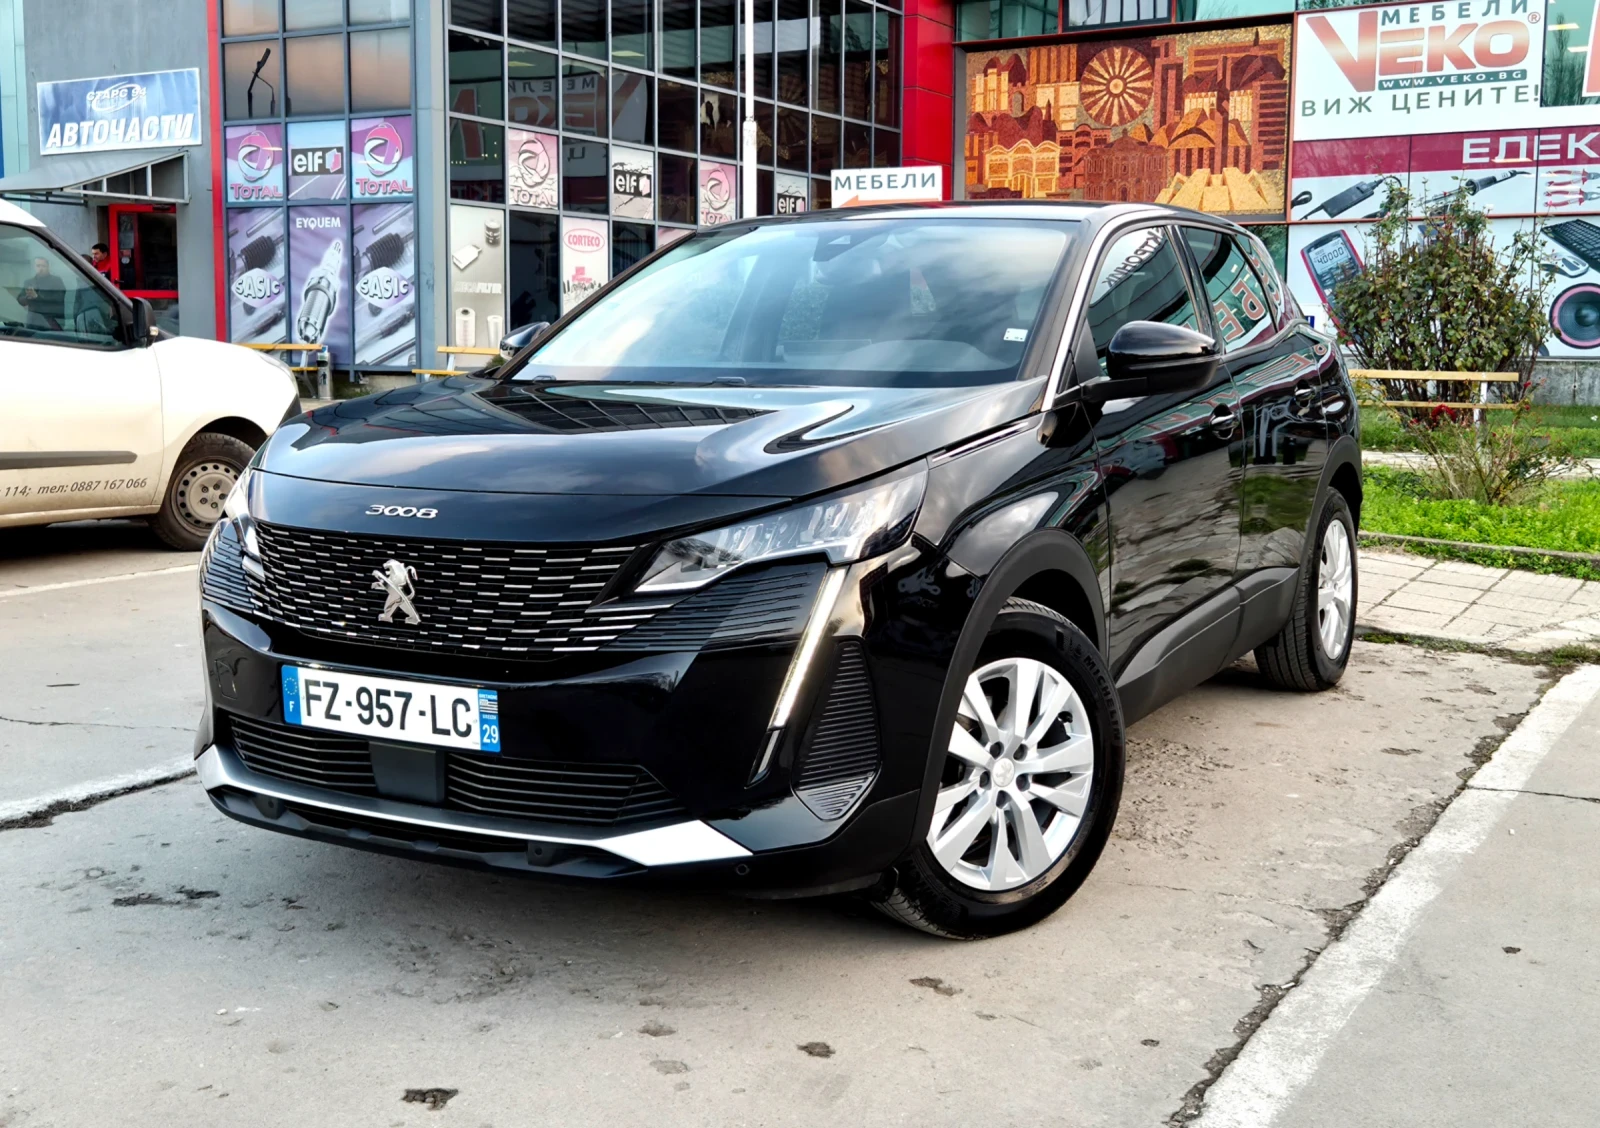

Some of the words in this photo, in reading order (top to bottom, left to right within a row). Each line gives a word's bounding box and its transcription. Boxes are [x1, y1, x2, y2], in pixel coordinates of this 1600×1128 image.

[1381, 0, 1528, 26] МЕБЕЛИ
[1306, 10, 1531, 93] VEKO
[1381, 70, 1523, 89] WWW.VEKO.BG
[1301, 96, 1373, 117] ВИЖ
[1391, 84, 1540, 114] ЦЕНИТЕ!
[46, 113, 195, 149] АВТОЧАСТИ
[293, 151, 323, 173] elf
[230, 183, 284, 200] TOTAL
[356, 178, 414, 197] TOTAL
[615, 174, 638, 194] elf
[834, 172, 936, 191] МЕБЕЛИ
[510, 186, 559, 206] TOTAL
[778, 197, 796, 214] elf
[296, 216, 341, 230] EYQUEM
[567, 234, 601, 248] CORTECO
[236, 276, 281, 300] SASIC
[360, 274, 409, 300] SASIC
[70, 480, 101, 492] 0887
[103, 479, 125, 490] 167
[126, 478, 148, 489] 066
[365, 504, 438, 519] 3008
[289, 701, 295, 713] F
[304, 678, 473, 739] FZ-957-LC
[482, 724, 499, 744] 29
